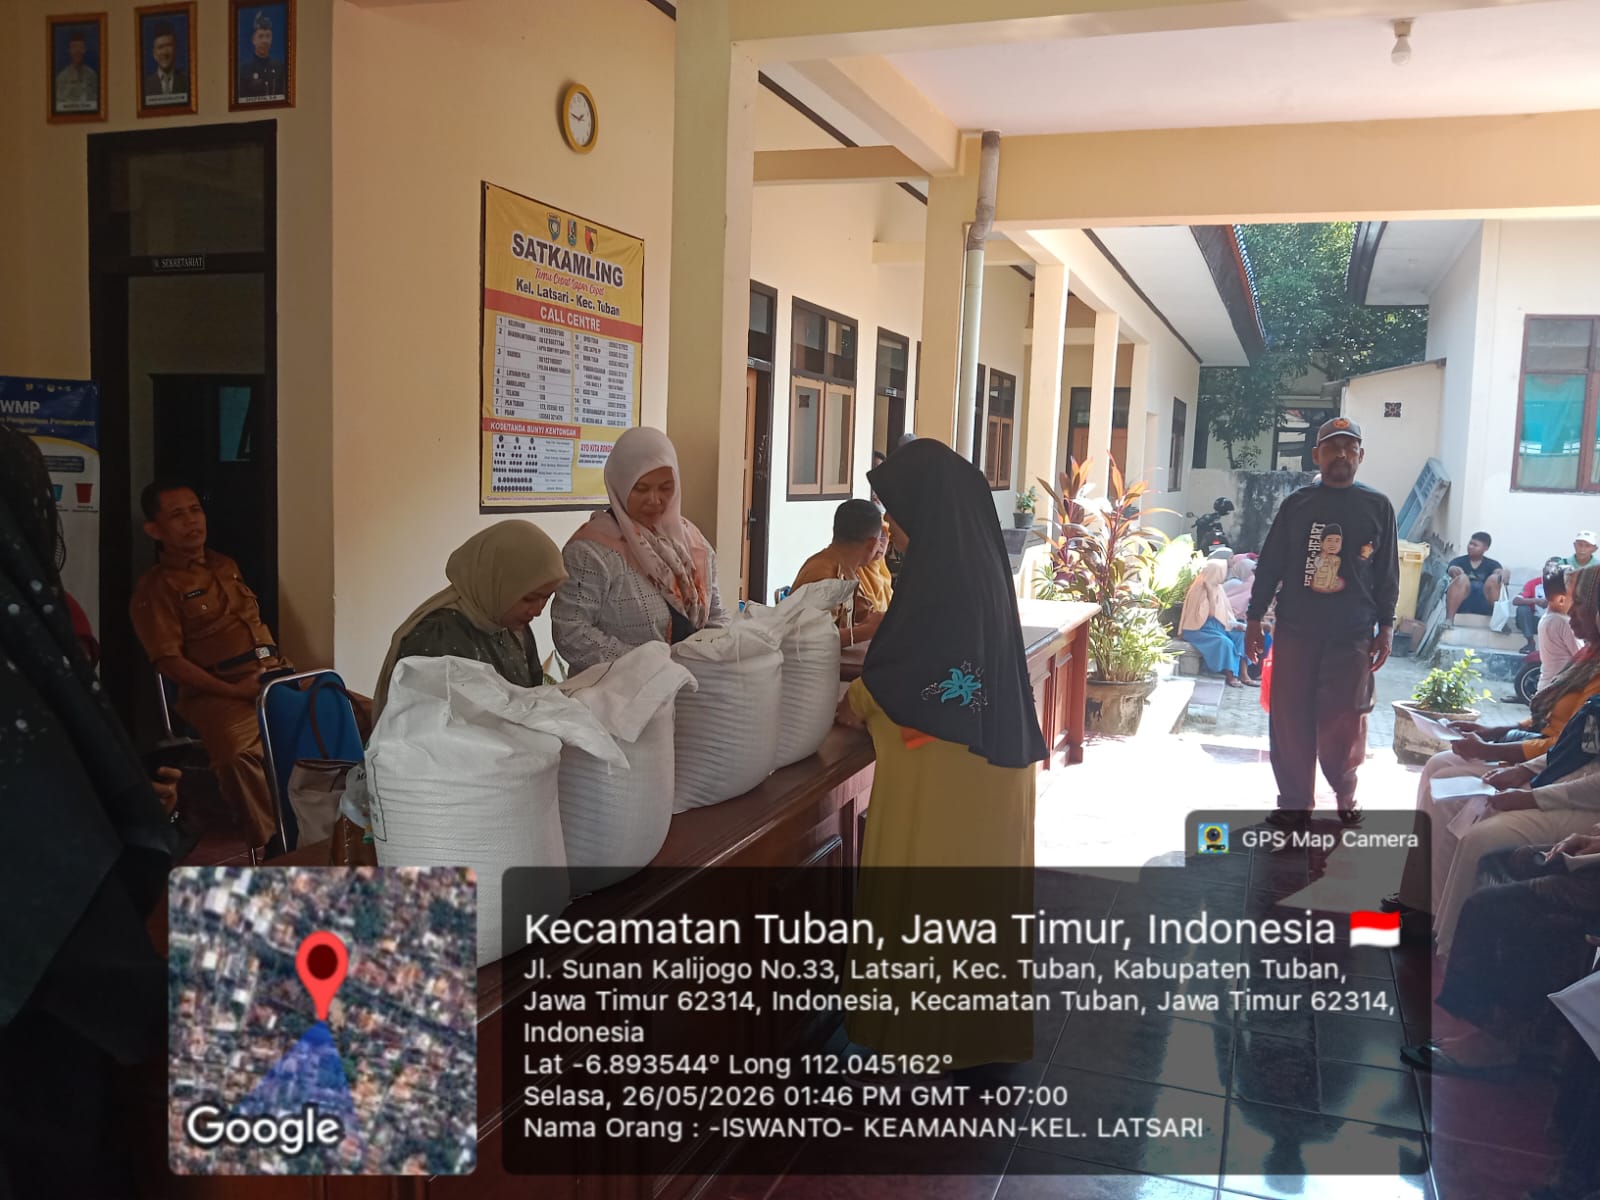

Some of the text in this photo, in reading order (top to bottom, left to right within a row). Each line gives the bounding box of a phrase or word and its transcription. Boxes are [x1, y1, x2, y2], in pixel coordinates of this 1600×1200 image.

[512, 233, 623, 287] SATKAMLING
[516, 278, 534, 295] Kel.
[537, 283, 569, 304] Latsari
[576, 296, 595, 310] Kec.
[597, 299, 620, 316] Tuban
[540, 306, 565, 323] CALL
[567, 312, 601, 332] CENTRE
